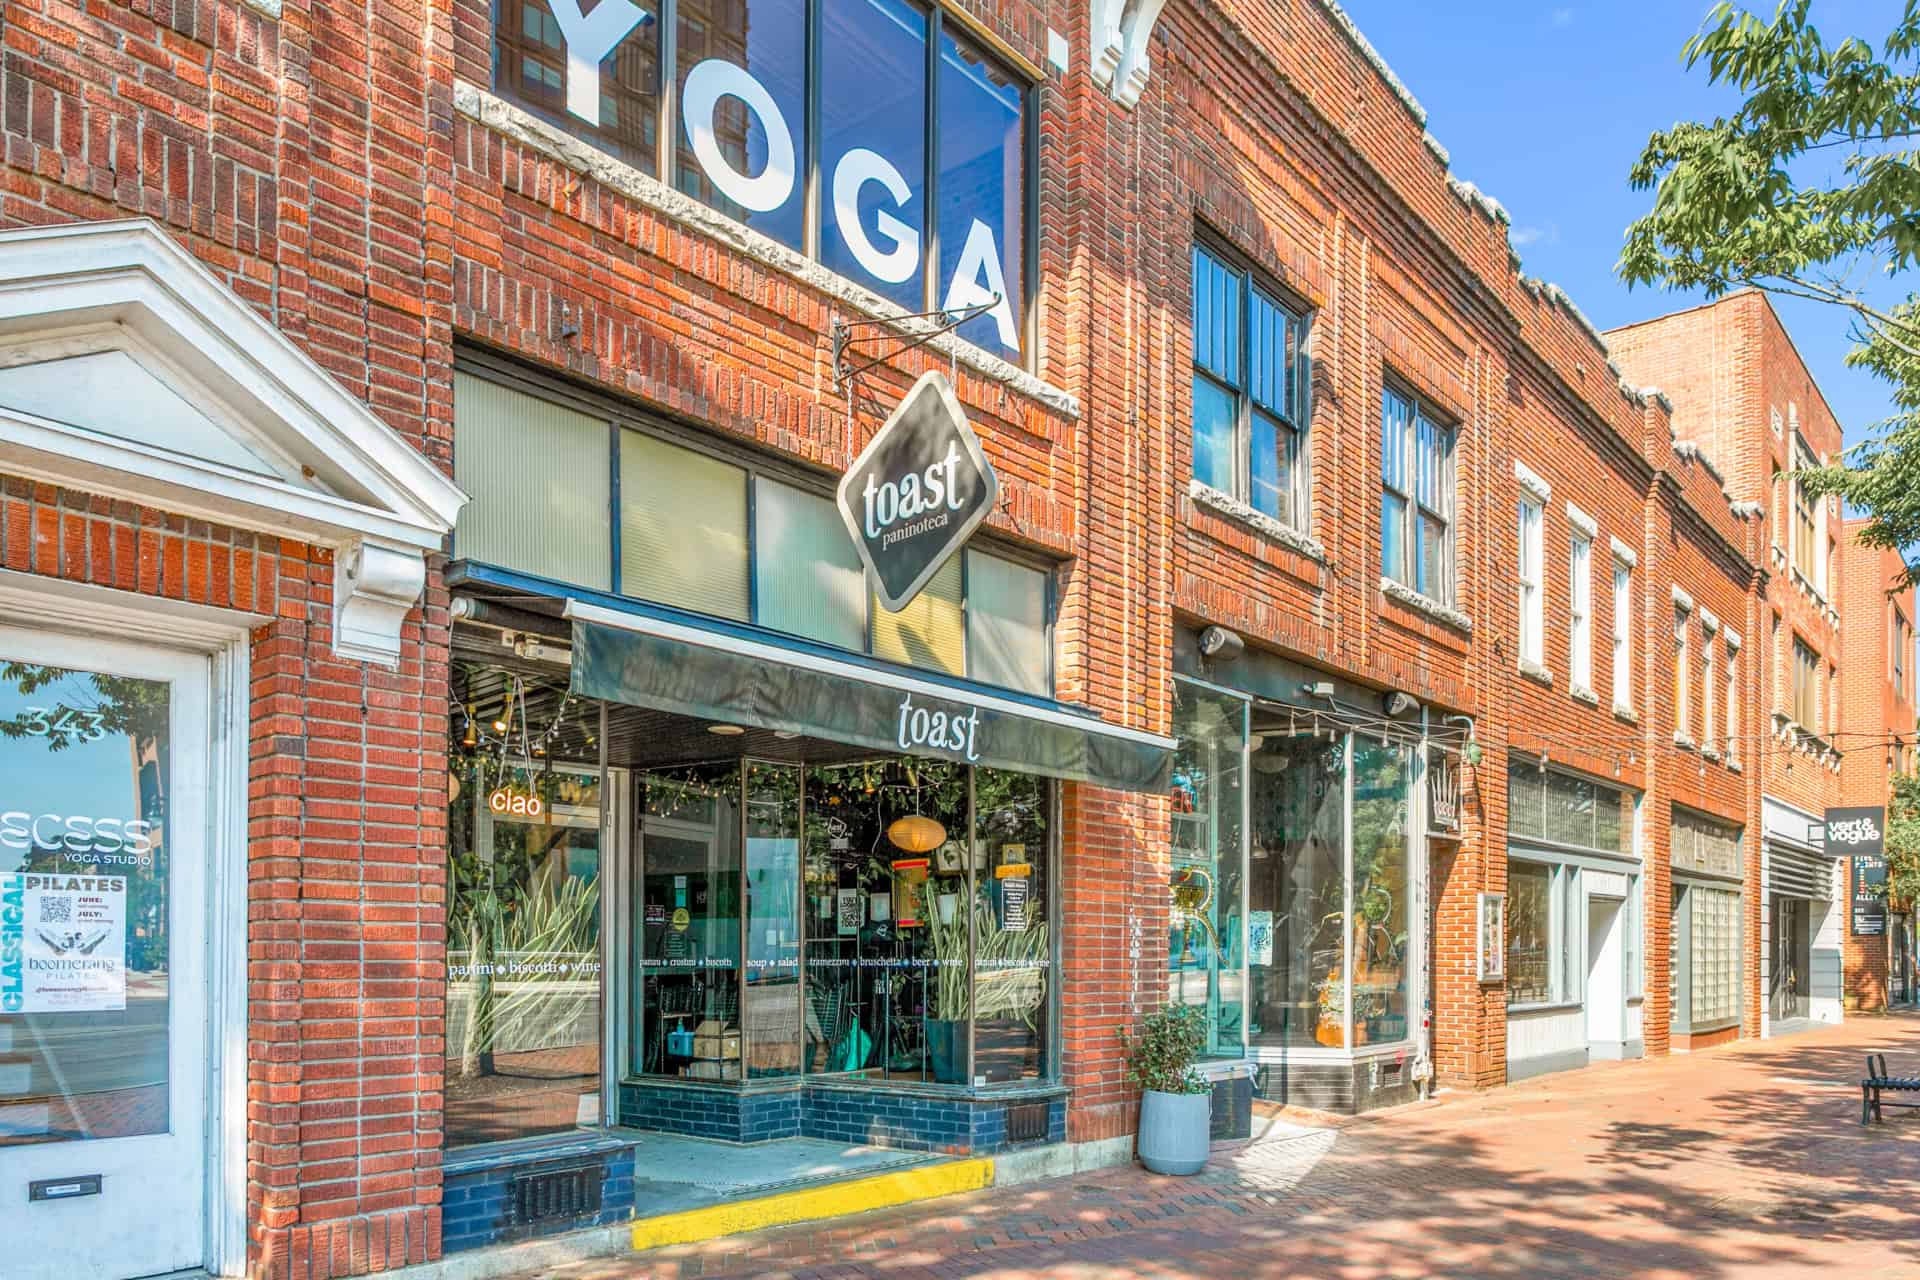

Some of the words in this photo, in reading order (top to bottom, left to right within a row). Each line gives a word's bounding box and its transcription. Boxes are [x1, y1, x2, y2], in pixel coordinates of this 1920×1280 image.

[550, 0, 1020, 353] YOGA
[862, 440, 965, 539] toast
[882, 512, 949, 551] paninoteca
[26, 706, 105, 741] 343
[898, 692, 980, 761] toast
[490, 789, 542, 816] ciao
[1828, 829, 1880, 844] vogue
[64, 852, 101, 863] YOGA
[103, 855, 151, 865] STUDIO
[26, 877, 123, 892] PILATES
[2, 875, 24, 1011] CLASSICAL
[29, 957, 115, 972] boomerang
[448, 961, 494, 979] panini
[509, 960, 557, 973] biscotti
[571, 961, 600, 973] wine
[746, 959, 767, 970] soup
[777, 956, 799, 967] salad
[912, 956, 930, 967] beer
